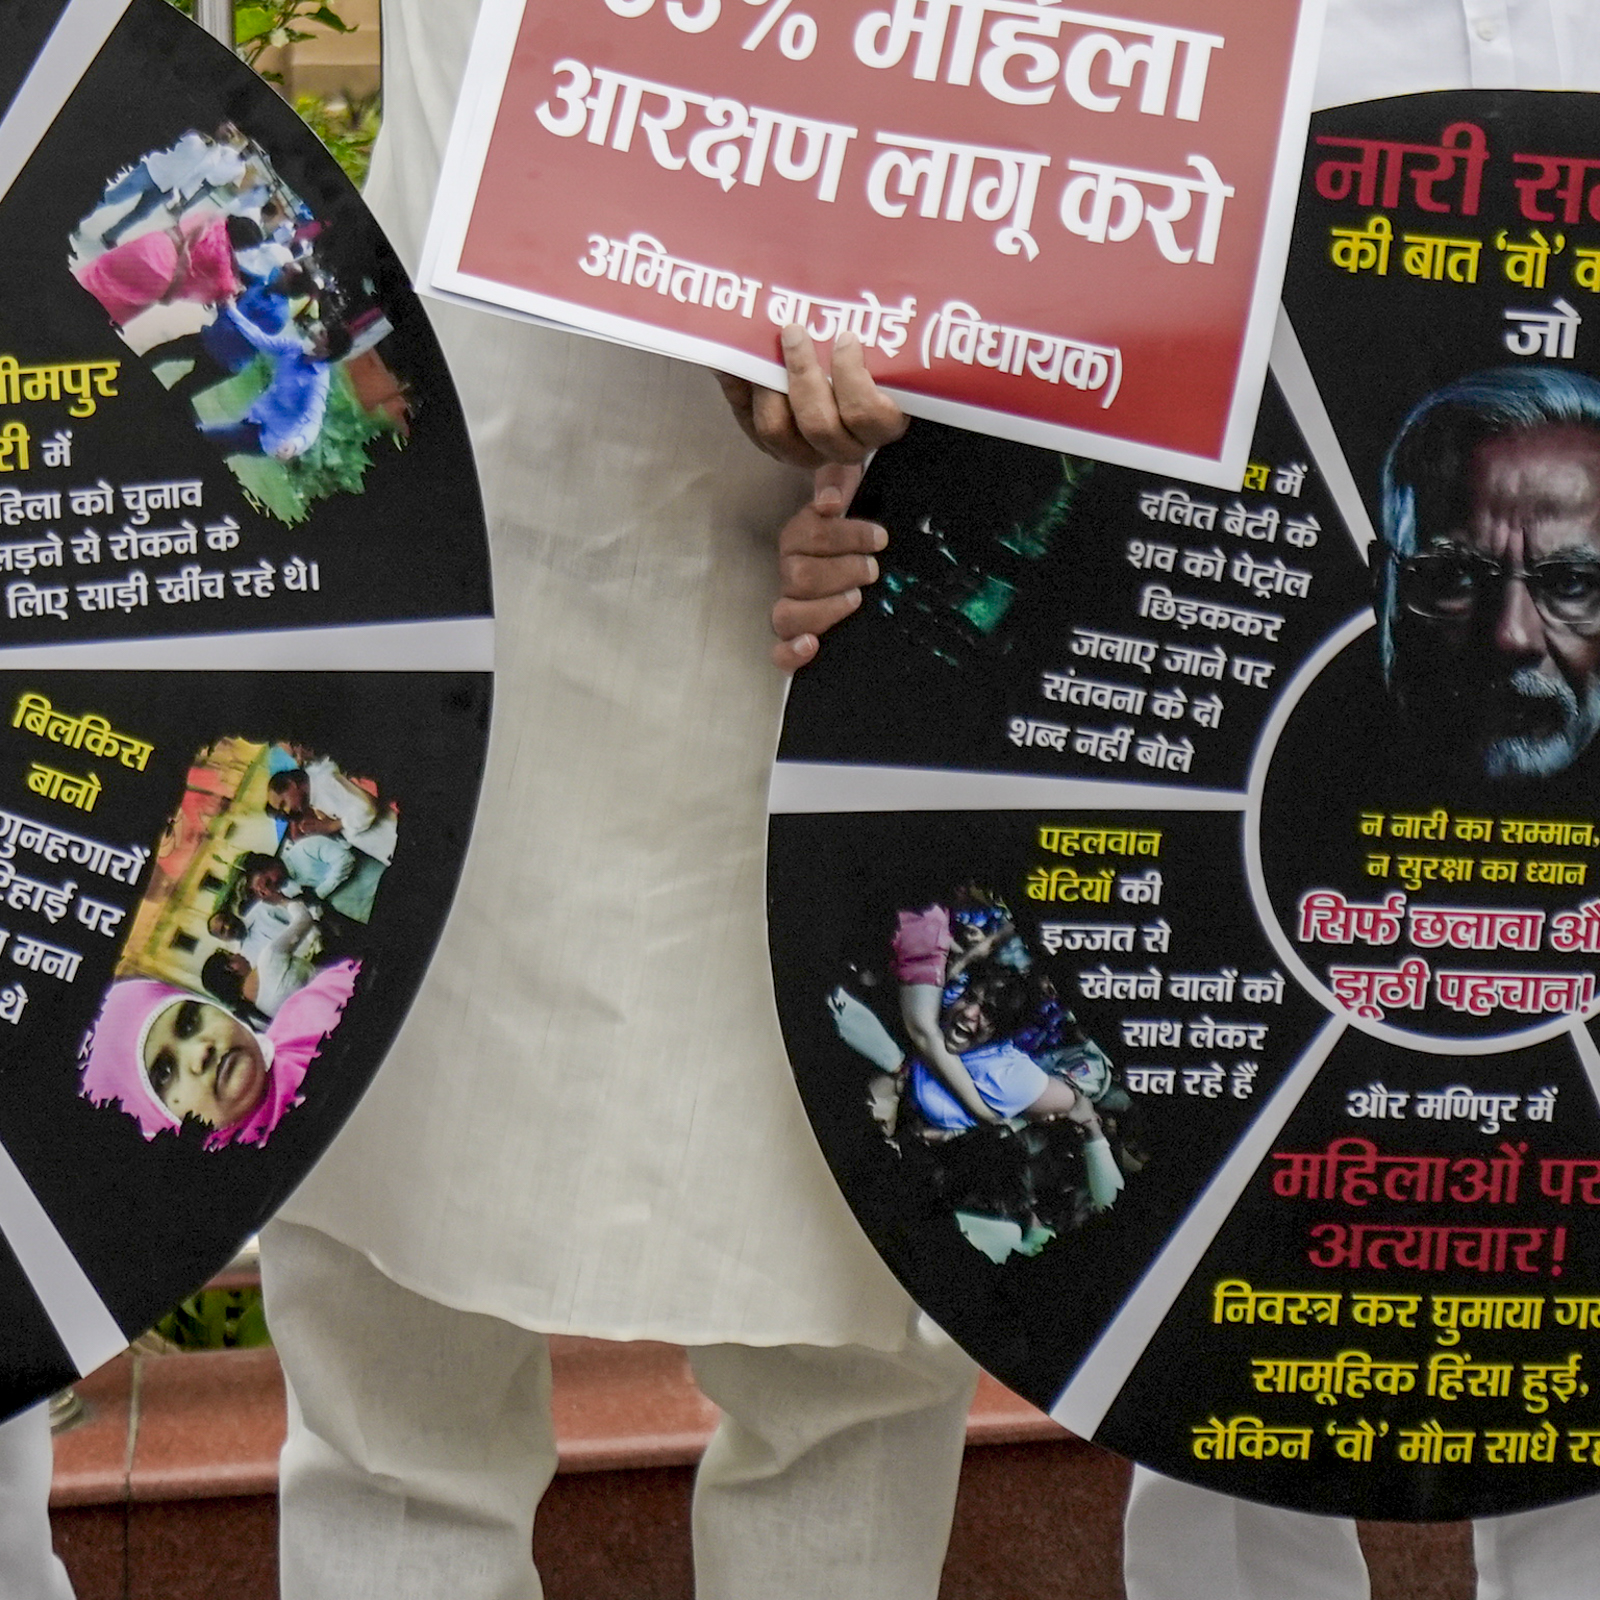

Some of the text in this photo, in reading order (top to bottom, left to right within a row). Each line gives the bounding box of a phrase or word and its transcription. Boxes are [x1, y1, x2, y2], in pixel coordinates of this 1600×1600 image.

[535, 59, 1234, 264] आरक्षण लागू करो
[1315, 122, 1490, 215] नारी
[578, 232, 762, 318] अमिताभ
[921, 300, 1122, 408] (विधायक)
[42, 430, 72, 466] में
[69, 479, 114, 516] को
[121, 480, 203, 525] चुनाव
[1275, 463, 1309, 498] में
[70, 527, 101, 564] से
[108, 519, 198, 560] रोकने
[205, 515, 240, 551] के
[1140, 489, 1321, 548] दलित बेटी के
[1127, 540, 1313, 598] शव को पेट्रोल
[1139, 584, 1285, 641] छिड़ककर
[1071, 628, 1275, 688] जलाए जाने पर
[13, 693, 154, 771] बिलकिस
[1151, 687, 1188, 720] के
[1192, 694, 1224, 728] दो
[1008, 717, 1195, 773] शब्द नहीं बोले
[28, 763, 102, 811] बानो
[1040, 827, 1162, 856] पहलवान
[1027, 867, 1163, 905] बेटियों की
[77, 896, 126, 937] पर
[1041, 918, 1172, 955] इज्जत से
[1298, 888, 1406, 945] सिर्फ
[1407, 904, 1546, 951] छलावा
[12, 934, 83, 982] मना
[1330, 958, 1595, 1019] झूठी पहचान!
[1122, 1015, 1268, 1050] साथ लेकर
[1346, 1081, 1558, 1134] और मणिपुर में
[1272, 1137, 1528, 1206] महिलाओं
[1309, 1224, 1566, 1276] अत्याचार!
[1252, 1350, 1589, 1413] सामूहिक हिंसा हुई,
[1192, 1416, 1313, 1460] लेकिन
[1399, 1419, 1476, 1463] मौन
[1485, 1421, 1559, 1463] साधे
